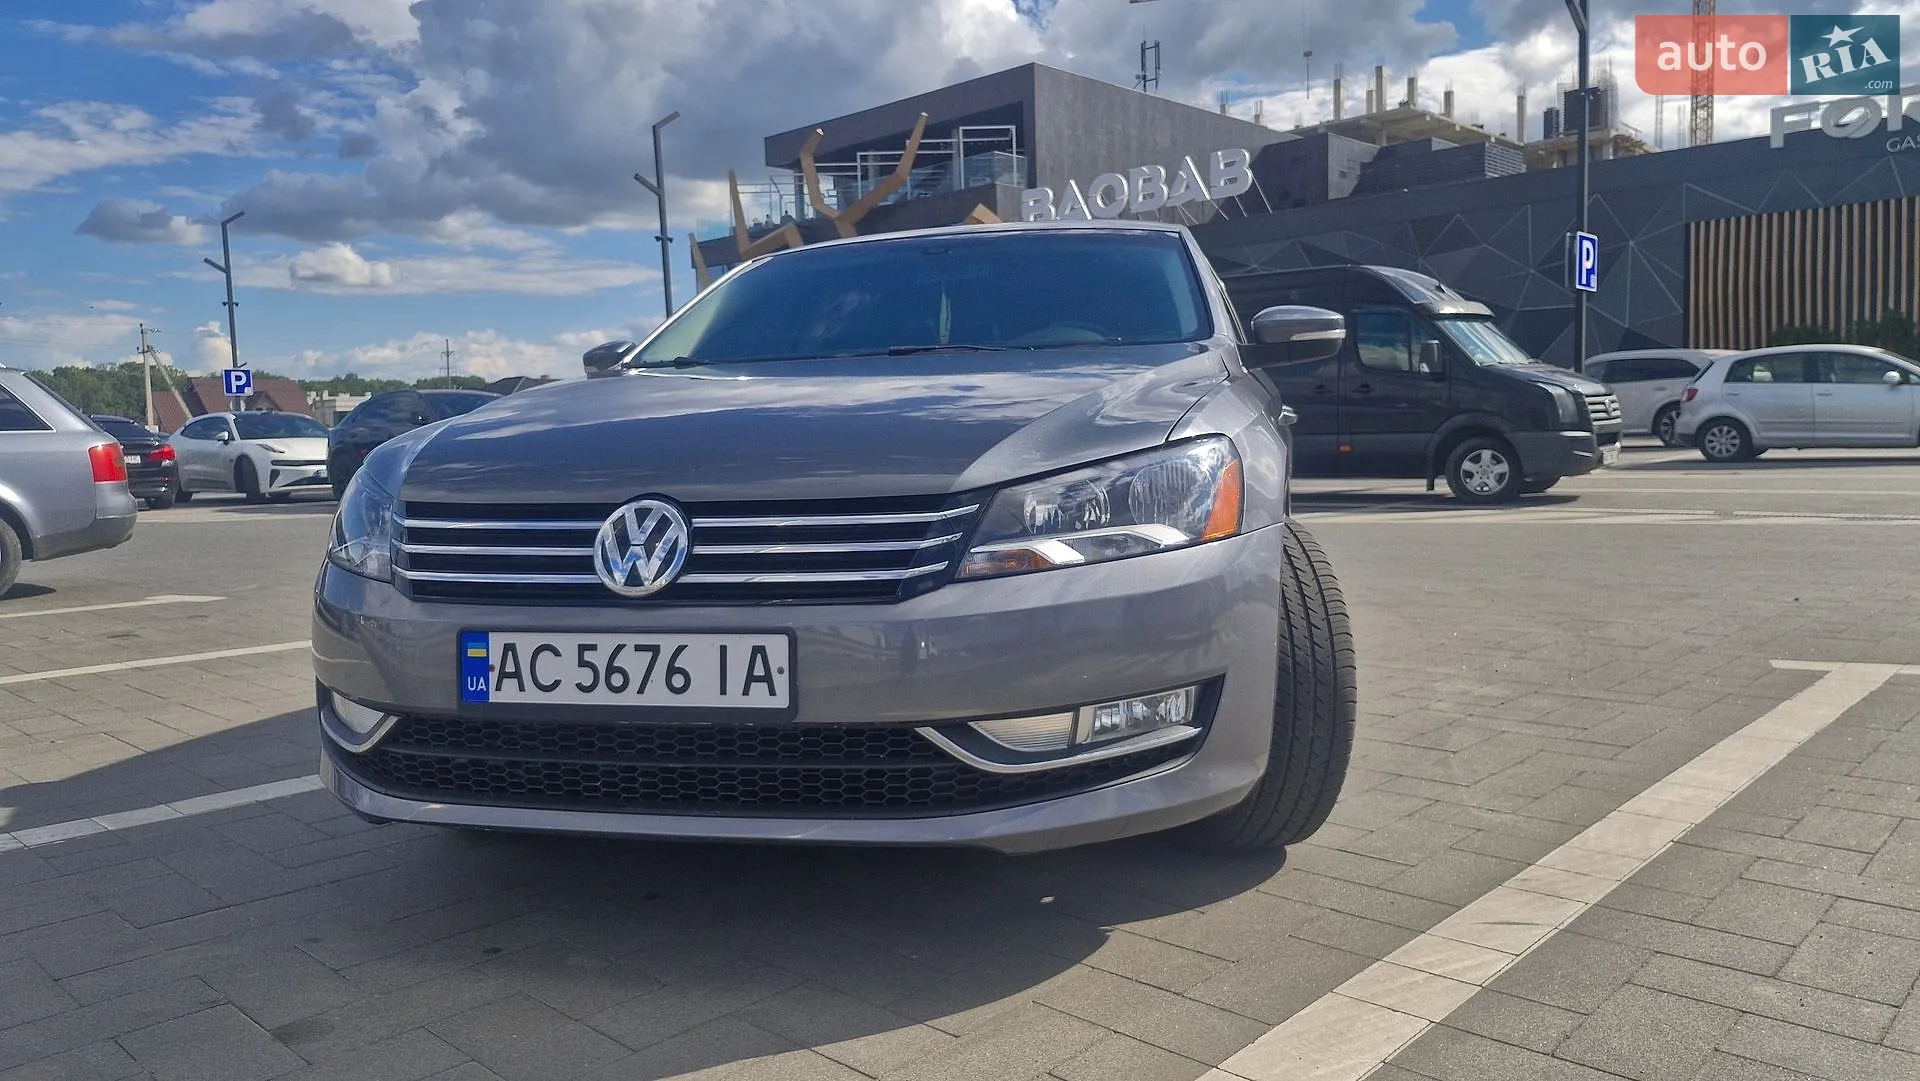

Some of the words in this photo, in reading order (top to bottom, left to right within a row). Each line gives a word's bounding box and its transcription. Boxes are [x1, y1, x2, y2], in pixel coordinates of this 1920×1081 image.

[1022, 149, 1253, 221] BAOBAB
[1582, 239, 1594, 285] P
[231, 371, 247, 393] P
[467, 677, 487, 692] UA
[495, 643, 563, 693] AC
[575, 643, 692, 695] 5676
